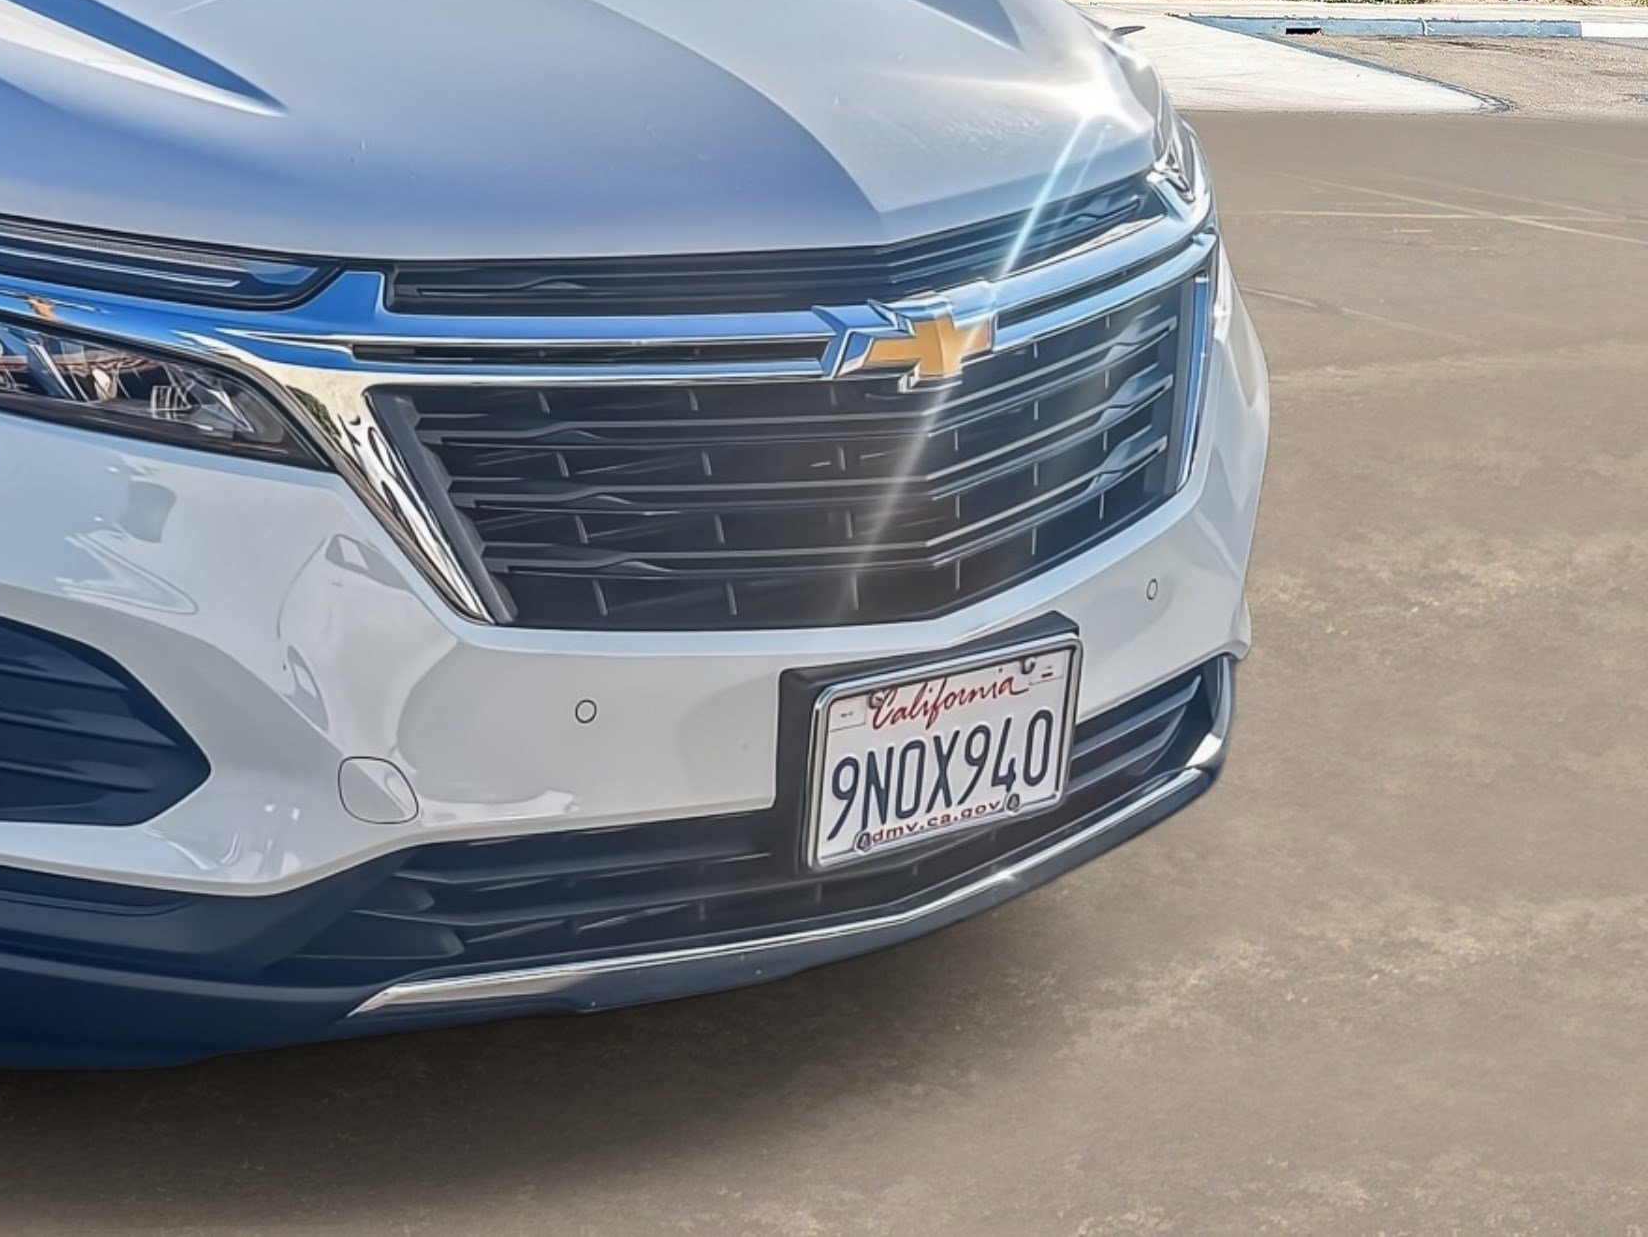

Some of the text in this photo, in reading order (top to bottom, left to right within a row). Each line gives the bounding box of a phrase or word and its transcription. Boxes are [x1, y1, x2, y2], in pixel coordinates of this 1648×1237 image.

[871, 668, 1029, 731] California
[826, 709, 1054, 842] 9NOX940
[871, 799, 1002, 843] dmv.ca.gov
